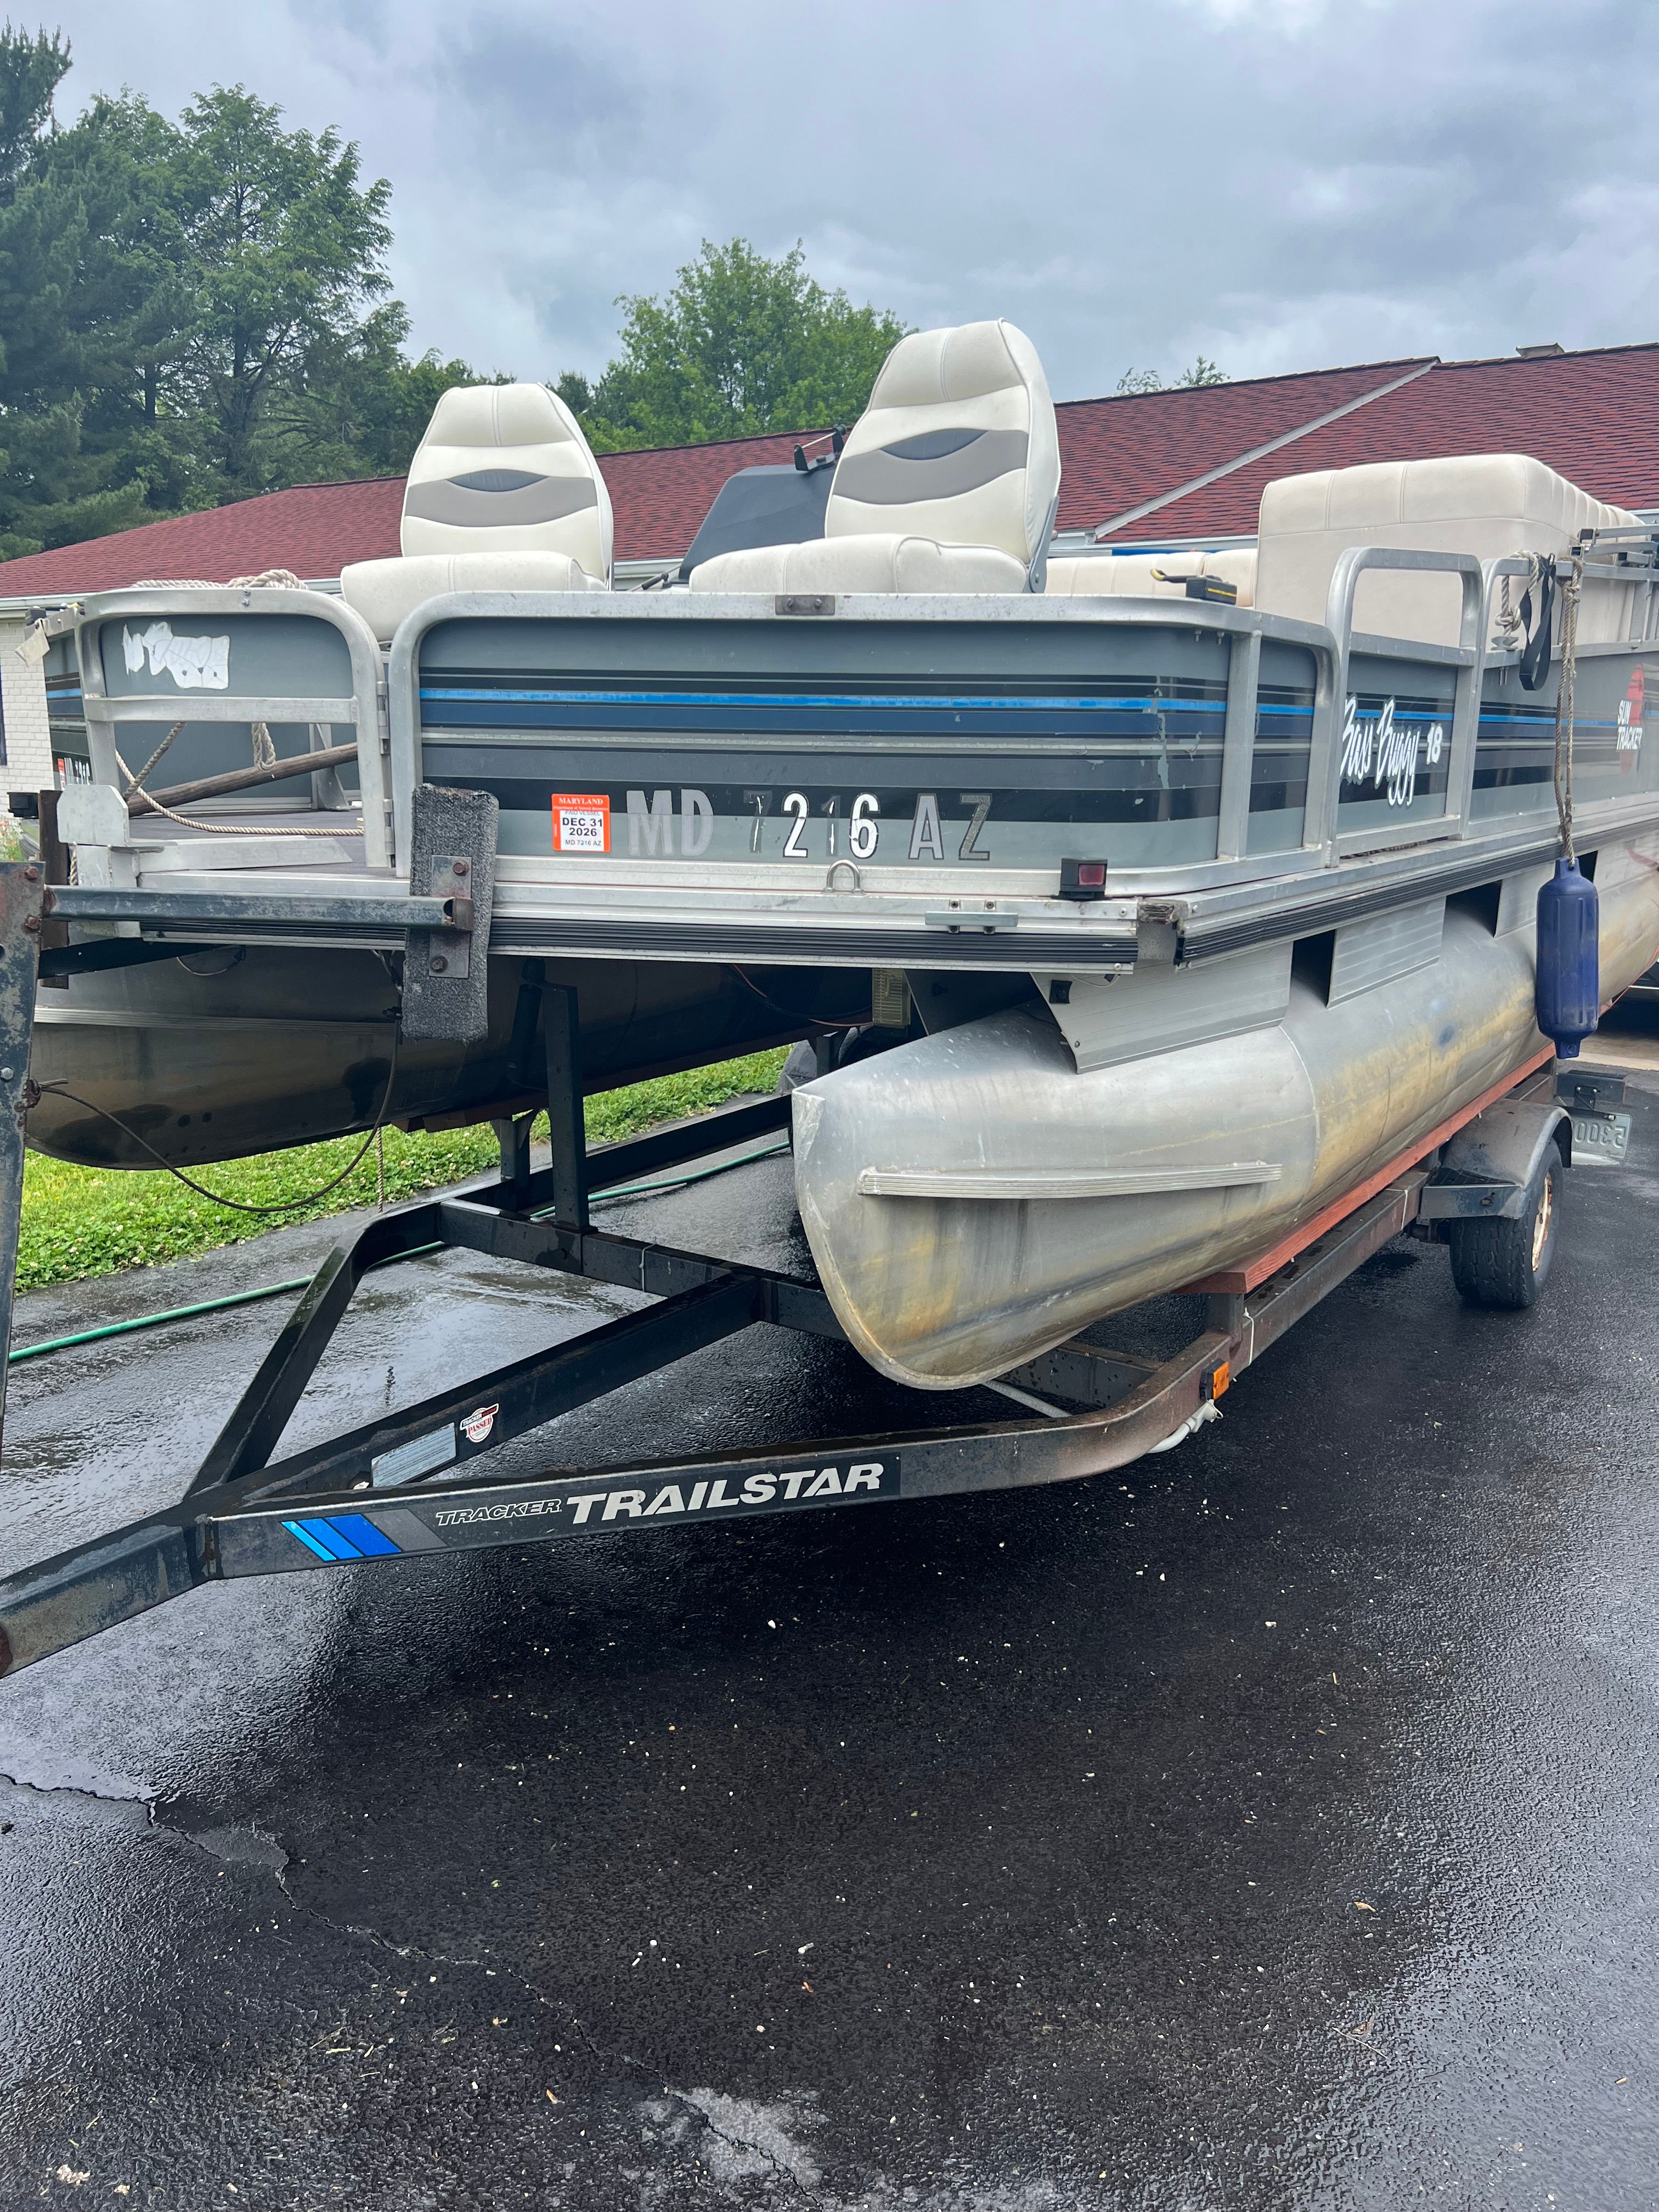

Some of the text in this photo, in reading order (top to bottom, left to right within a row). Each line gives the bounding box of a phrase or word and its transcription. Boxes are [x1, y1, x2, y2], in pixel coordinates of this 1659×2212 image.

[1618, 699, 1632, 725] SUN
[1616, 726, 1643, 749] TRACKER
[1376, 699, 1420, 806] Buggy
[1426, 725, 1443, 765] 18
[562, 817, 602, 827] DEC 31
[569, 827, 597, 837] 2026
[626, 789, 993, 861] MD 7216 AZ
[468, 1417, 492, 1435] PASSED
[436, 1463, 884, 1526] TRACKER TRAILSTAR
